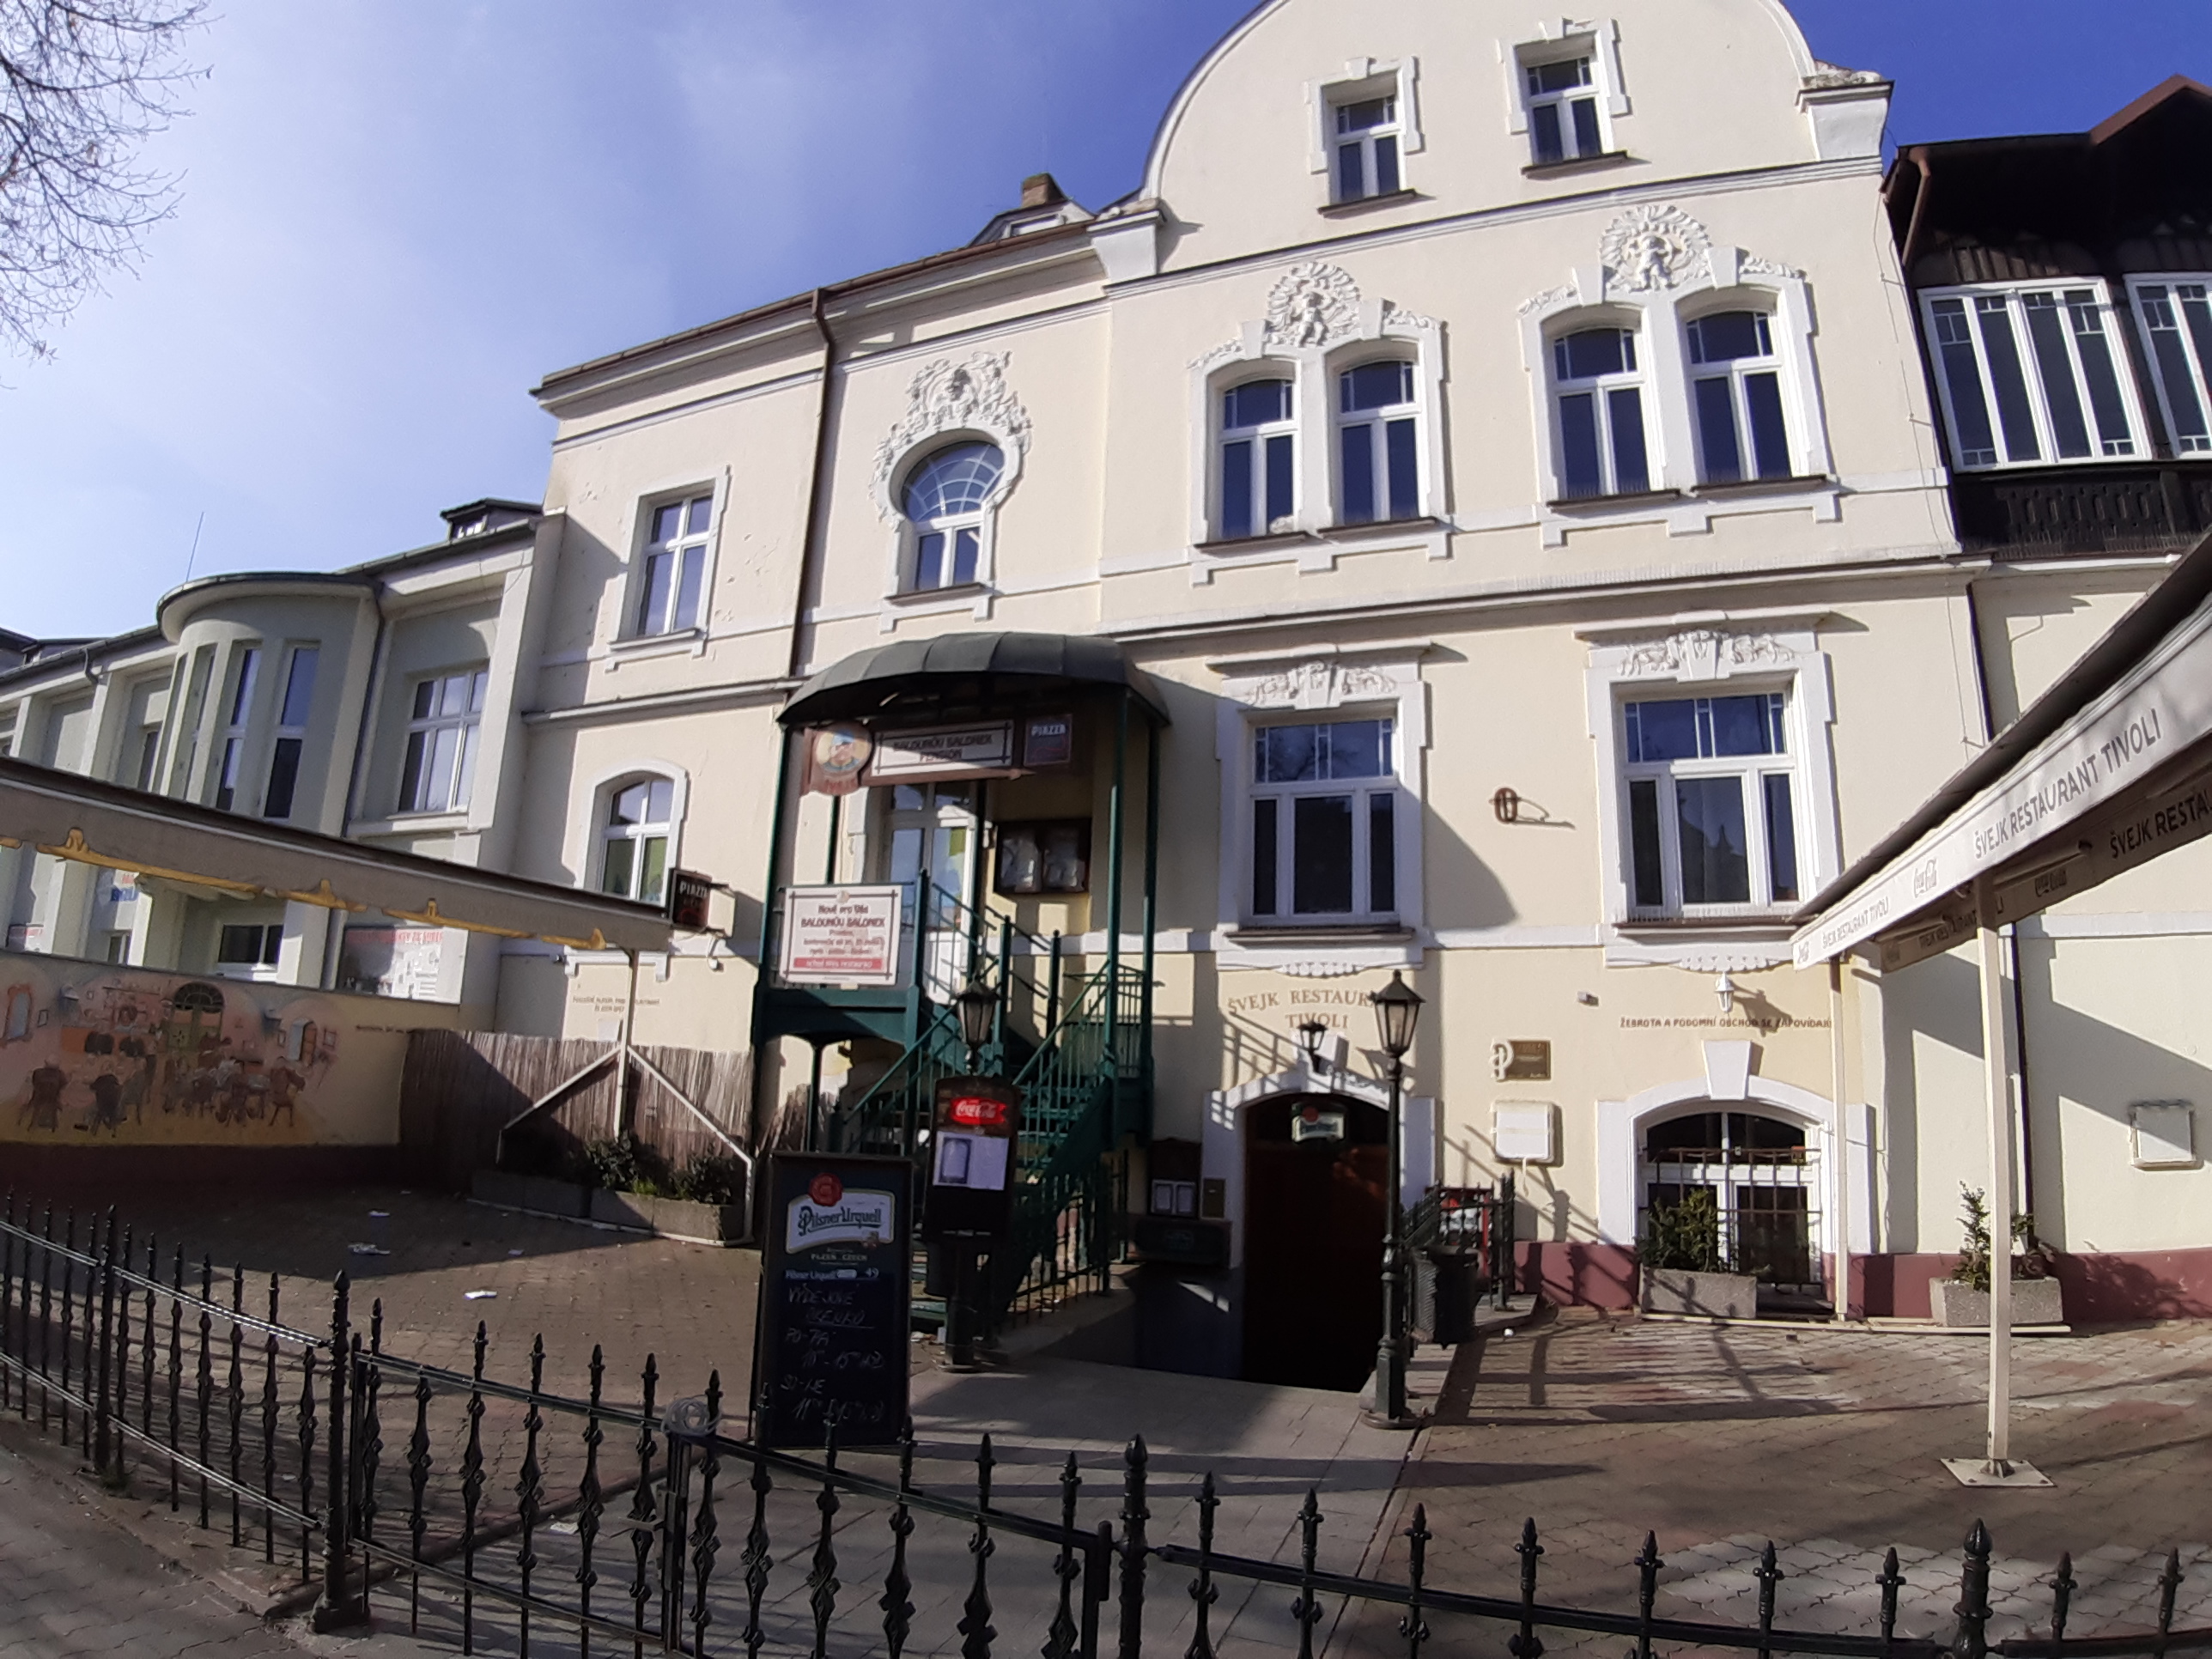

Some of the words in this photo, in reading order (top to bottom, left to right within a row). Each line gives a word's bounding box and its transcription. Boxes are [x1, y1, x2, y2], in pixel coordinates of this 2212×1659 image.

[1975, 817, 2009, 860] ŠVEJK
[2009, 752, 2099, 837] RESTAURANT
[2100, 708, 2161, 774] TIVOLI
[2110, 830, 2154, 860] ŠVEJK
[1227, 992, 1279, 1013] ŠVEJK
[1290, 989, 1376, 1008] RESTAUR
[1285, 1012, 1350, 1029] TIVOLI
[1664, 1018, 1671, 1028] A
[798, 1206, 841, 1237] Pilsner
[841, 1206, 881, 1229] Urquell
